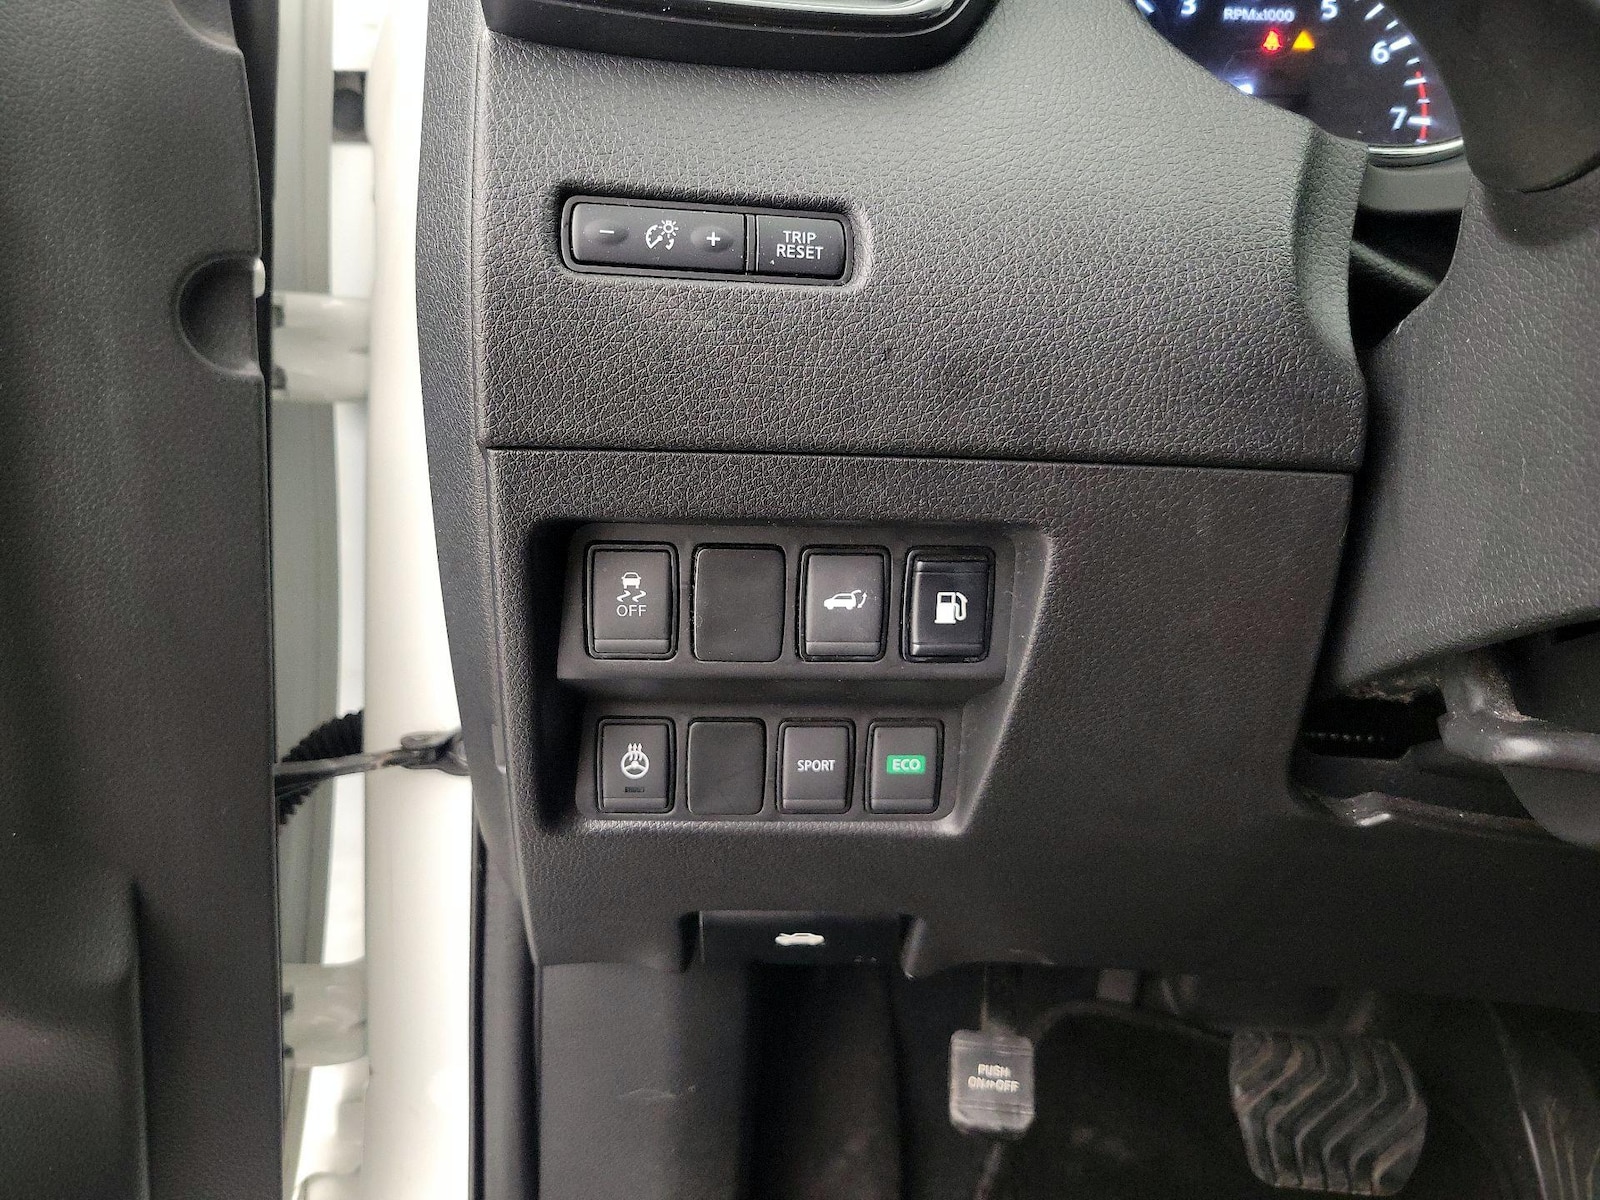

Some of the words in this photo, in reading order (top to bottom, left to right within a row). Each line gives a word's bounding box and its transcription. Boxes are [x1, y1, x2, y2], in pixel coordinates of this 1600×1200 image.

[1223, 7, 1296, 22] RPMx1000
[1320, 0, 1338, 20] 5
[1371, 40, 1390, 65] 6
[1389, 106, 1408, 131] 7
[782, 230, 817, 244] TRIP
[776, 243, 824, 260] RESET
[616, 604, 647, 617] OFF
[797, 759, 836, 772] SPORT
[892, 758, 921, 771] ECO
[977, 1063, 1012, 1078] PUSH
